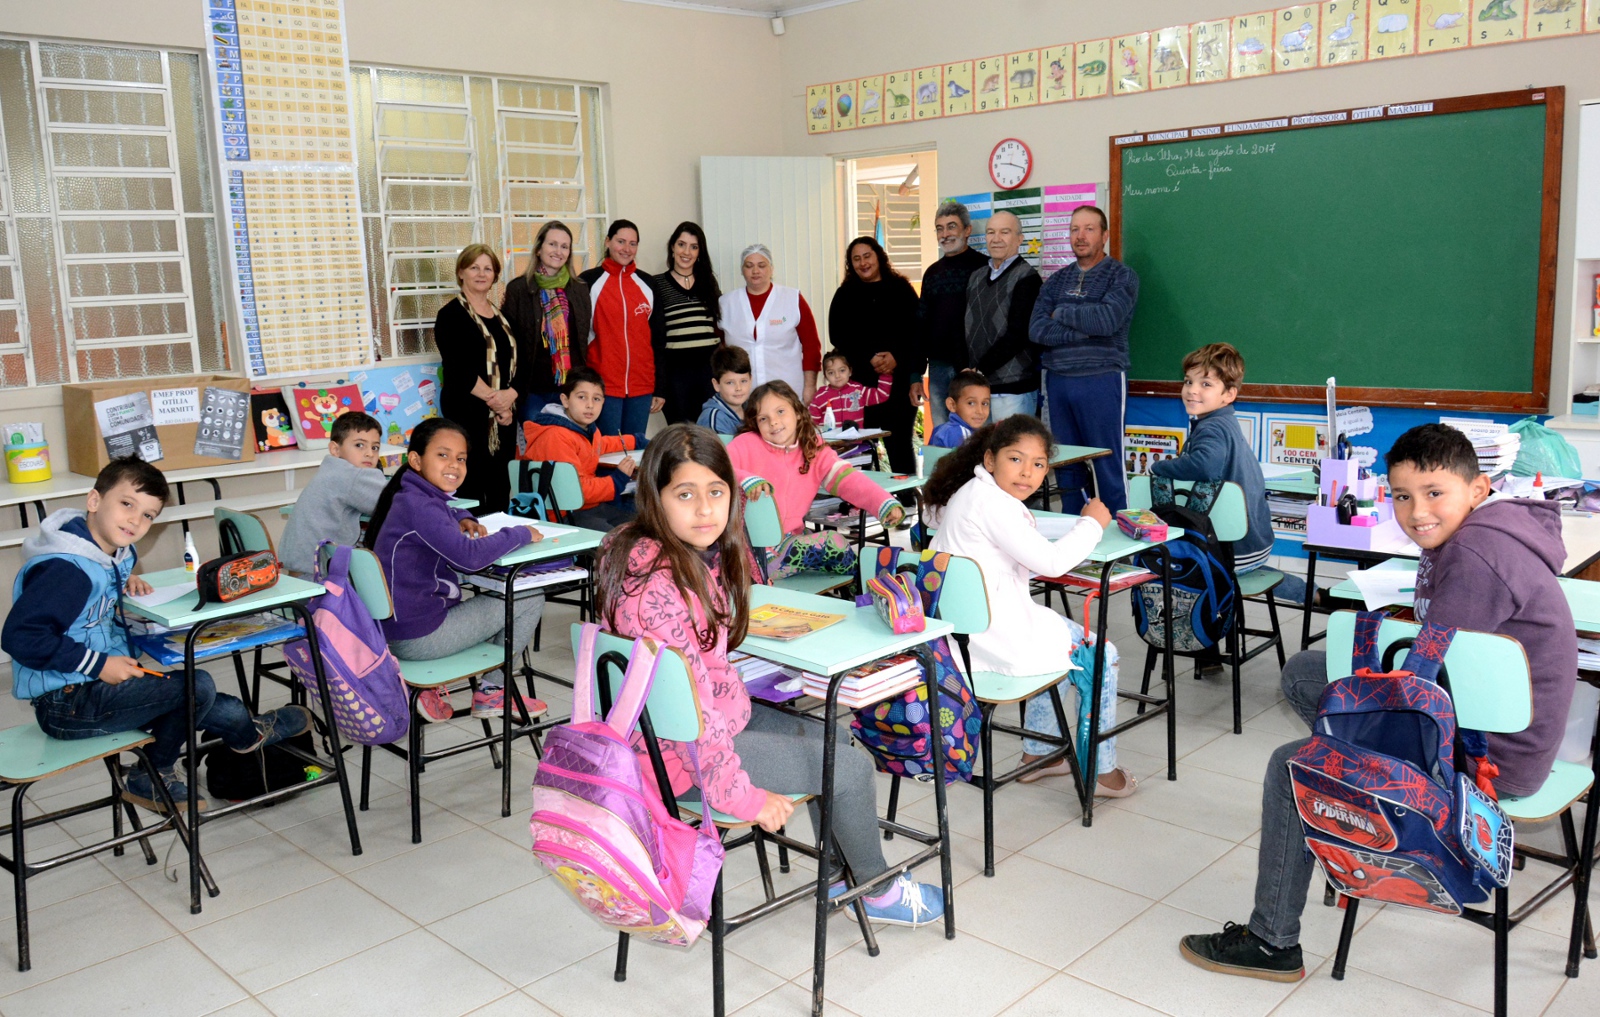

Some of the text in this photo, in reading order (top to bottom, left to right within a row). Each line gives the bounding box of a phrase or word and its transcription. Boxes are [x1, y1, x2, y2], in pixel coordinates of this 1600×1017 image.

[227, 12, 234, 20] G
[230, 25, 235, 33] J
[230, 38, 236, 46] L
[836, 85, 841, 93] B
[862, 80, 868, 88] C
[890, 76, 895, 84] D
[918, 71, 923, 79] E
[948, 66, 953, 75] F
[980, 61, 986, 70] G
[1012, 56, 1019, 65] H
[1081, 45, 1086, 54] J
[1118, 39, 1125, 49] K
[1196, 25, 1207, 35] M
[1239, 18, 1248, 29] N
[1283, 11, 1292, 21] O
[1329, 4, 1337, 14] P
[229, 50, 239, 58] M
[232, 63, 239, 71] N
[837, 120, 842, 128] b
[890, 112, 895, 120] d
[949, 104, 954, 113] f
[980, 101, 986, 110] g
[1013, 94, 1019, 103] h
[1079, 85, 1084, 96] j
[1119, 80, 1125, 90] k
[1196, 70, 1206, 78] m
[1239, 64, 1246, 73] n
[1328, 52, 1336, 63] p
[1377, 44, 1384, 56] q
[1428, 37, 1434, 47] r
[1480, 30, 1487, 40] s
[1537, 21, 1543, 32] t
[234, 75, 240, 83] P
[235, 87, 242, 95] R
[238, 124, 244, 132] V
[1116, 103, 1432, 145] ESCOLA MUNICIPAL ENSINO FUNDAMENTAL PROFESSORA OTILIA MARMITT
[241, 149, 247, 157] Z
[1126, 149, 1141, 165] Rio
[1142, 151, 1155, 161] da
[1194, 147, 1206, 157] de
[1208, 144, 1233, 165] agosto
[1236, 144, 1249, 155] de
[1251, 142, 1276, 155] 2017
[1122, 184, 1142, 197] Meu
[1144, 185, 1170, 195] nome
[1005, 199, 1028, 207] DEZENA
[153, 390, 174, 398] EMEF
[106, 402, 136, 414] CONTRIBUA
[158, 405, 195, 414] MARMITT
[109, 413, 145, 428] COMUNIDADE
[1347, 425, 1370, 434] unidades
[1299, 450, 1317, 458] CEM
[1313, 800, 1378, 837] SPIDER-MAN
